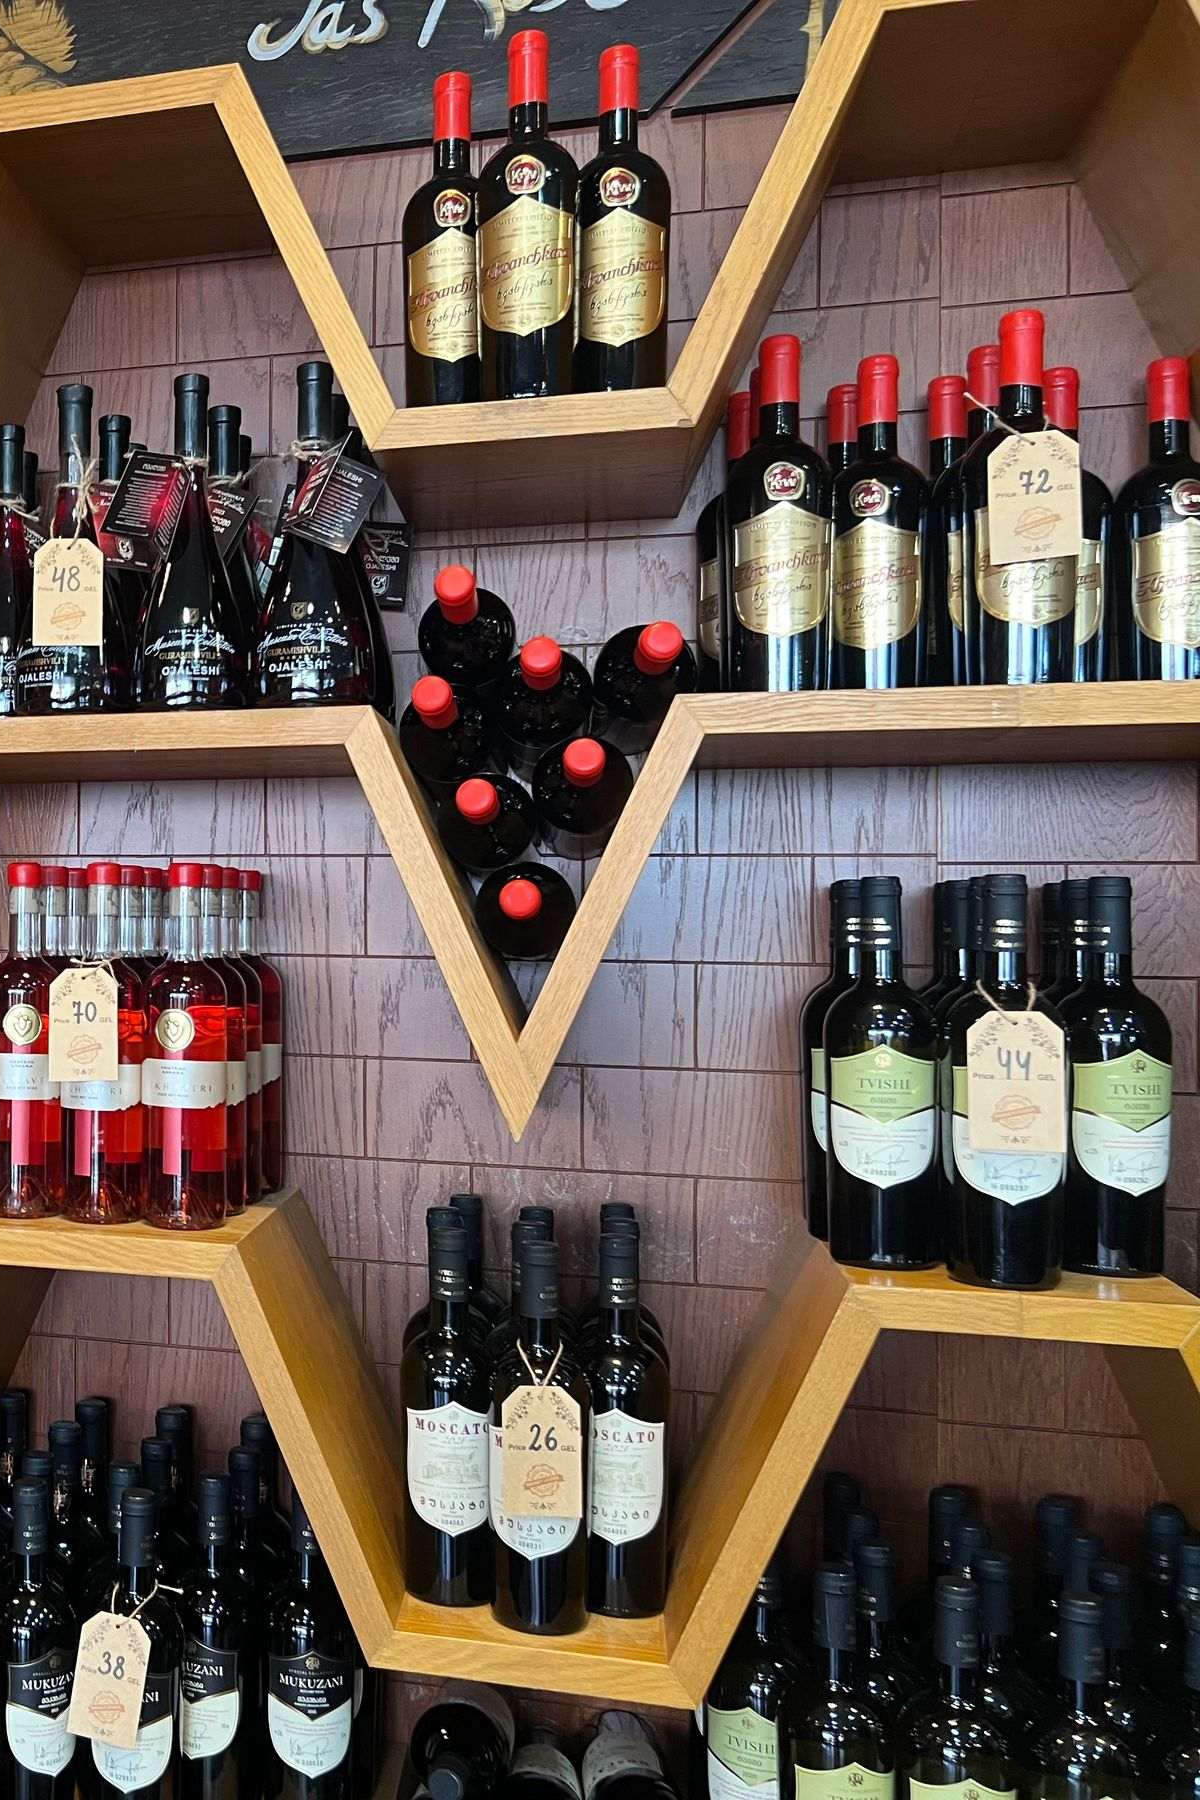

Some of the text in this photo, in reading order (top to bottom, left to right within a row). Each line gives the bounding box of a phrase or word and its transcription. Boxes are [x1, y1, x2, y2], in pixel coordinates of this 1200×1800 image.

[1018, 468, 1053, 496] 72
[52, 565, 81, 593] 48
[161, 664, 220, 676] OJALESHI
[269, 660, 328, 674] OJALESHI
[19, 672, 64, 684] OJALESHI
[71, 1000, 98, 1025] 70
[997, 1047, 1032, 1080] 44
[857, 1078, 911, 1090] TVISHI
[1110, 1083, 1162, 1096] TVISHI
[416, 1417, 490, 1435] MOSCATO
[529, 1424, 558, 1451] 26
[593, 1429, 655, 1444] SCATO
[591, 1505, 650, 1520] უსკატი
[98, 1651, 125, 1680] 38
[185, 1663, 224, 1677] UZANI
[22, 1671, 74, 1691] MUKUZA
[279, 1672, 344, 1690] MUKUZANI
